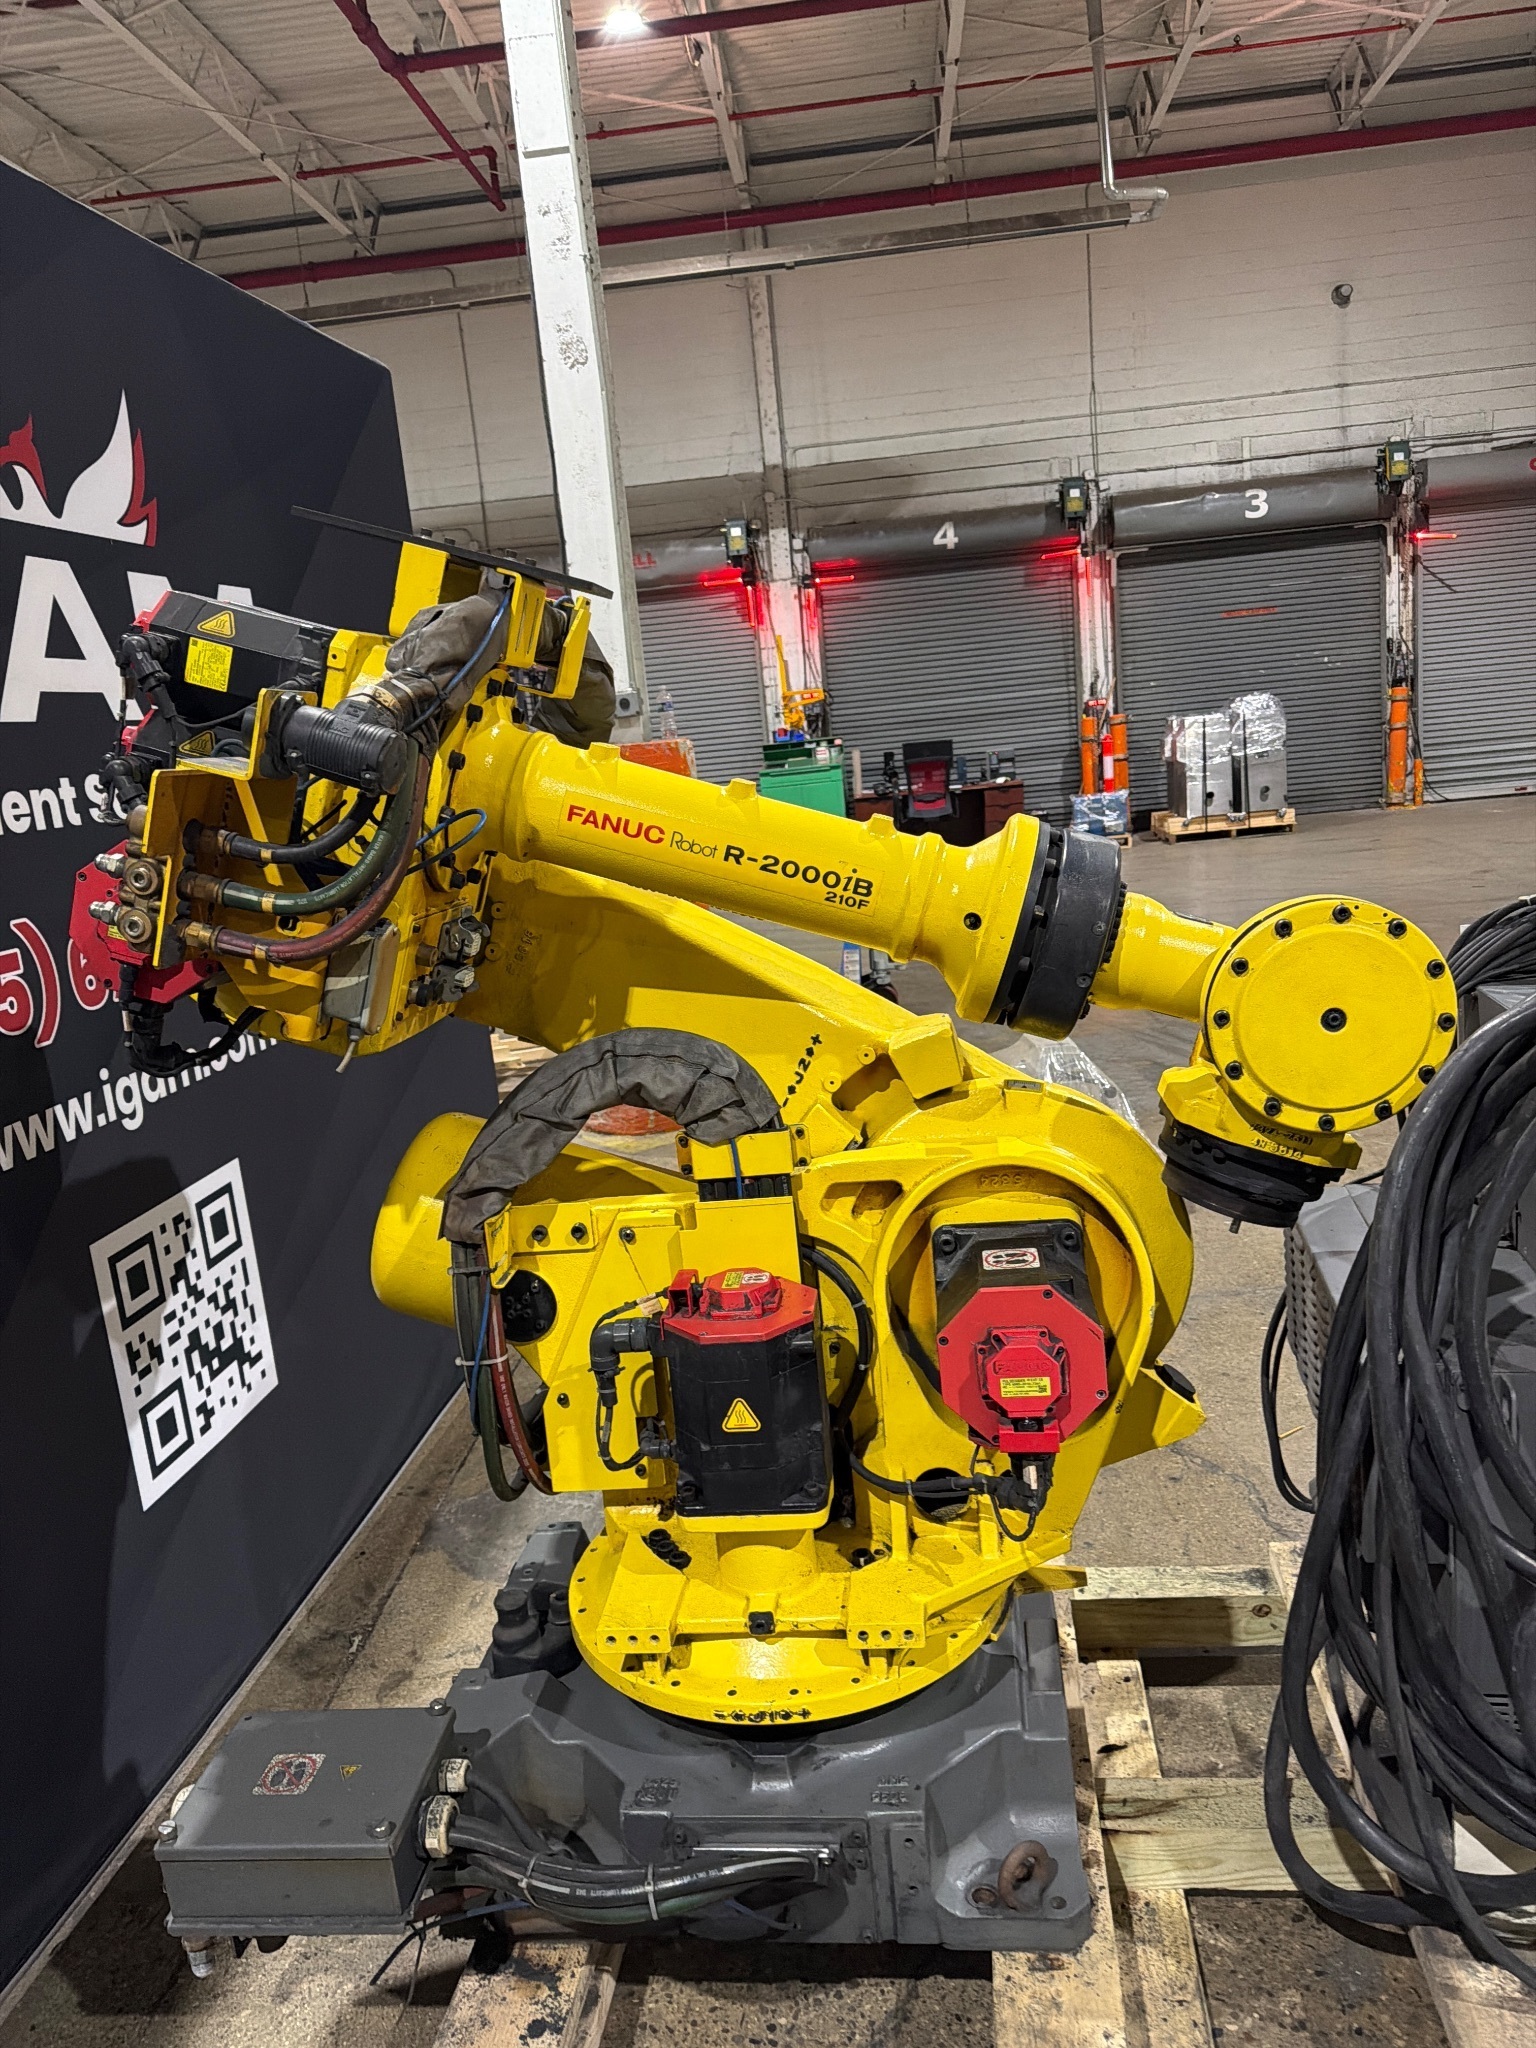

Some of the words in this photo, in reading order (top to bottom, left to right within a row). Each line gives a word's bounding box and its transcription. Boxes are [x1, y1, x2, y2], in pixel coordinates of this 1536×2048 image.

[1244, 488, 1269, 519] 3
[932, 521, 959, 550] 4
[0, 777, 82, 835] ent
[566, 804, 666, 844] FANUC
[669, 830, 719, 859] Robot
[723, 844, 874, 898] R-2000iB
[823, 891, 870, 910] 210F
